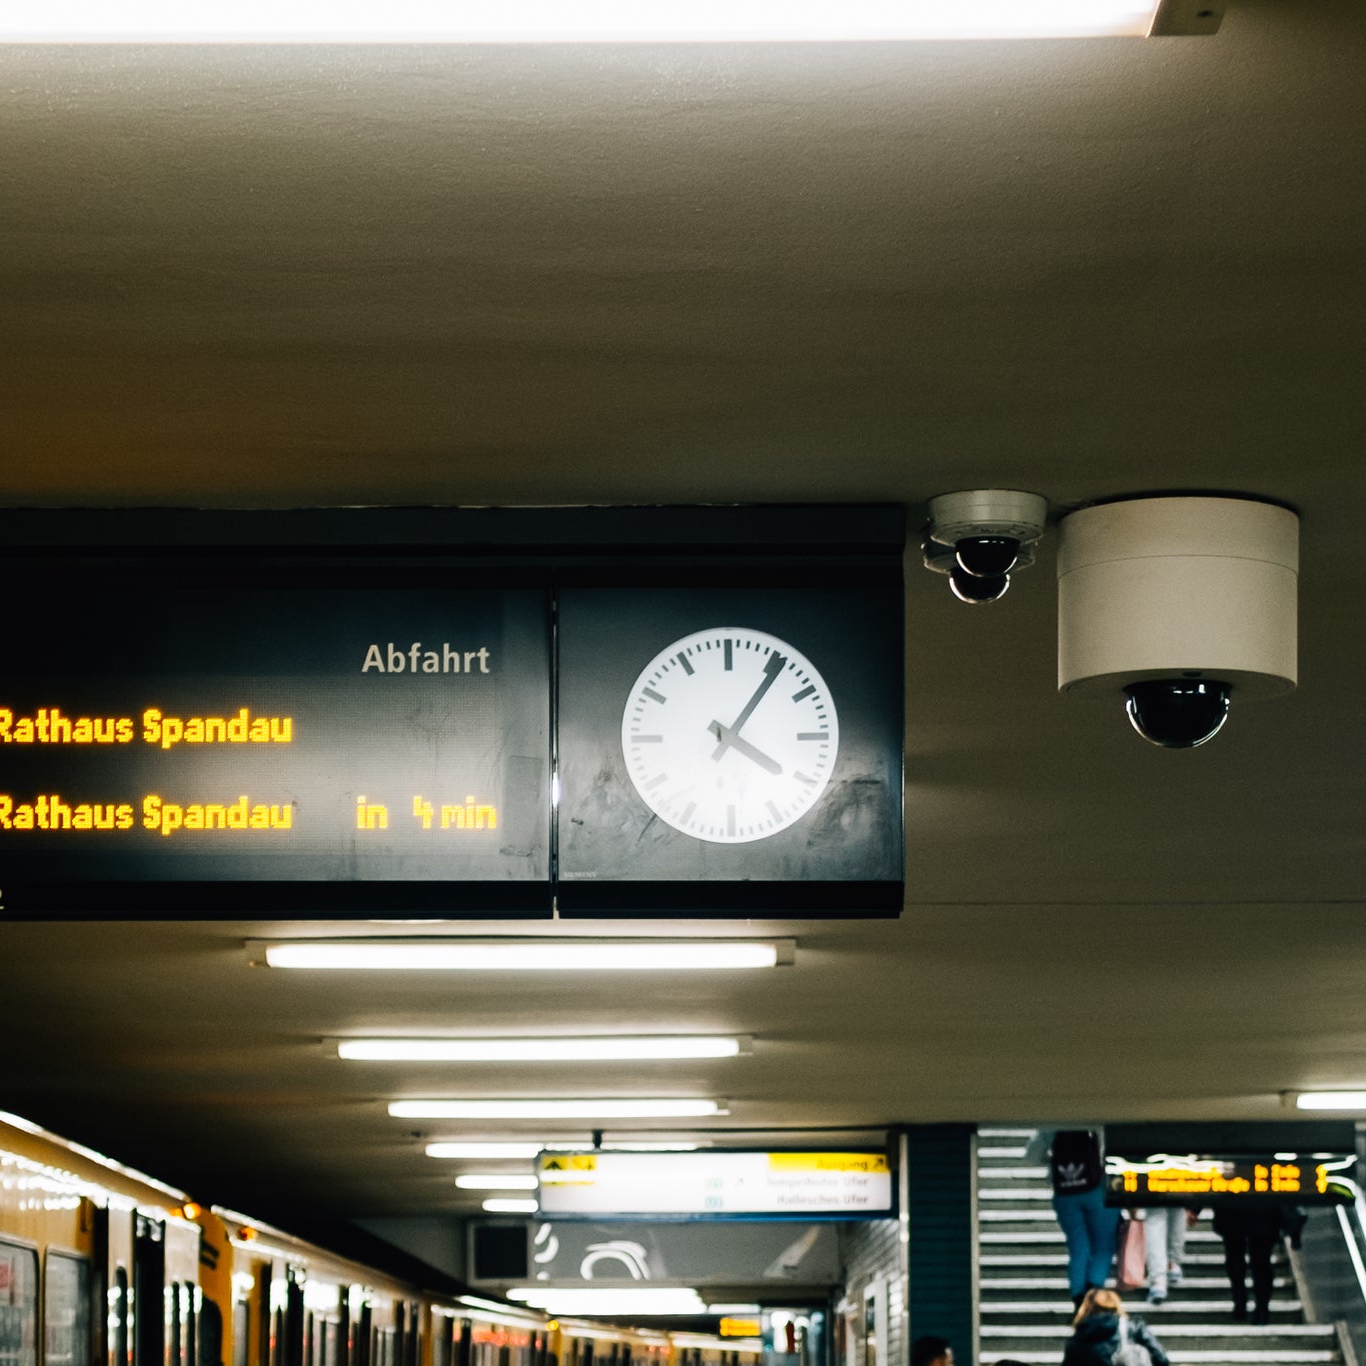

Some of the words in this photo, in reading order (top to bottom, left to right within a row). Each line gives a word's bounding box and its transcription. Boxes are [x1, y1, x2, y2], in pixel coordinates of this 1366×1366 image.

[361, 643, 490, 674] Abfahrt
[143, 708, 292, 749] Spandau
[143, 795, 292, 836] Spandau
[357, 795, 388, 829] in
[413, 795, 434, 829] 4
[440, 795, 497, 829] min
